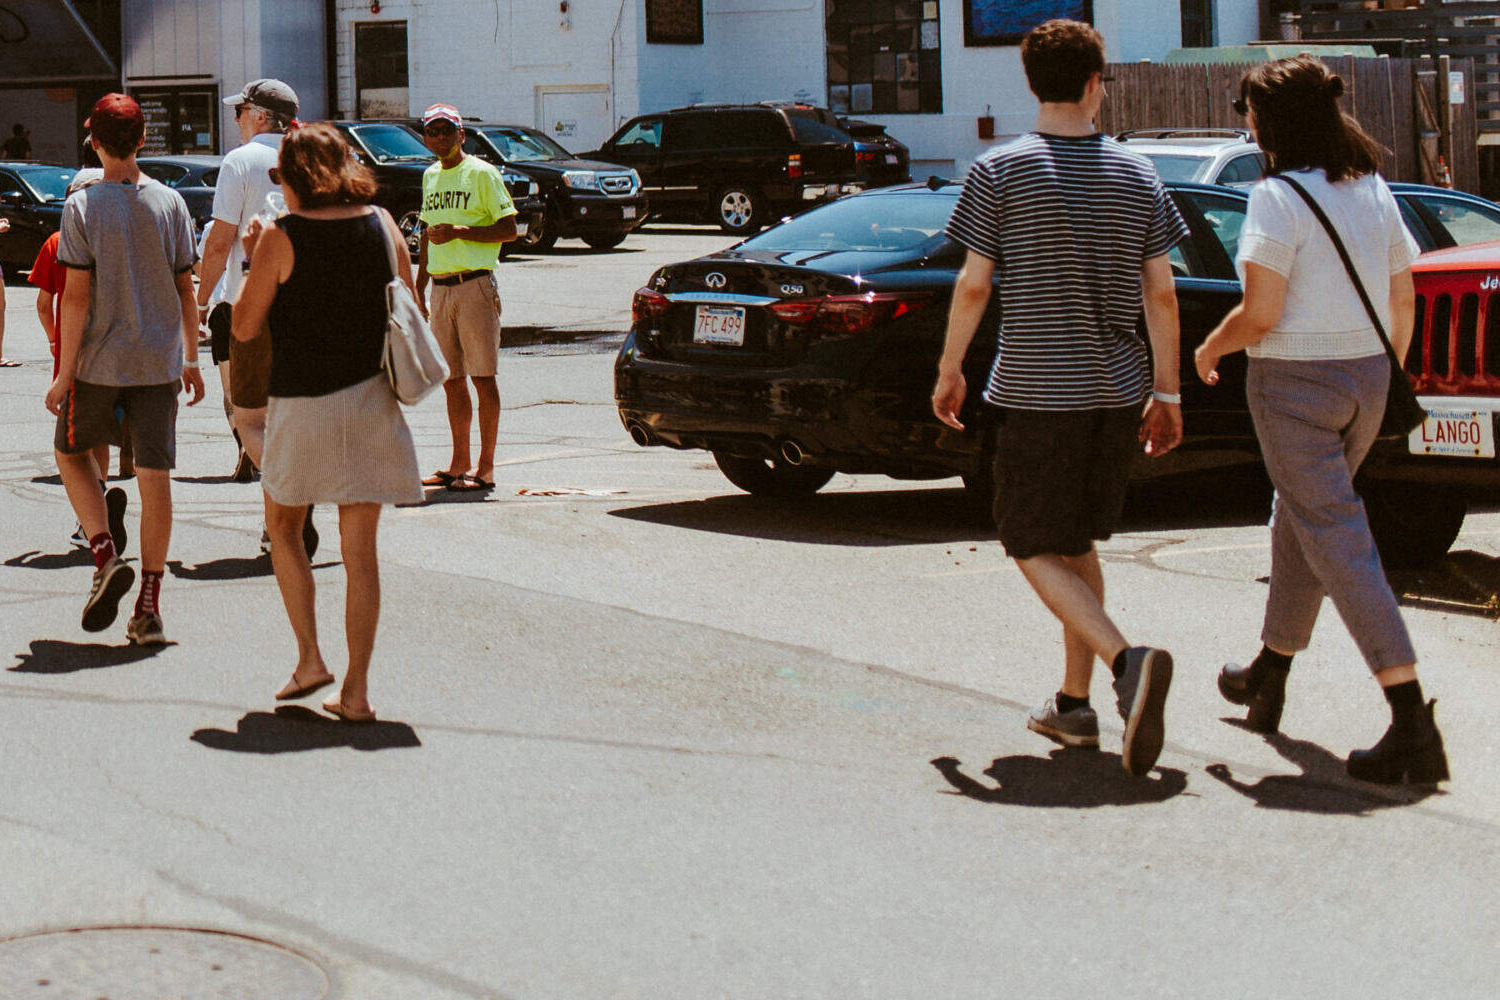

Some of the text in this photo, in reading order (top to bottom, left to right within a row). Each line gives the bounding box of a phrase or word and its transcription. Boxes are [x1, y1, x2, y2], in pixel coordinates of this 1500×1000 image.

[424, 190, 471, 211] SECURITY
[780, 284, 804, 295] Q50
[1480, 274, 1500, 290] Je
[698, 315, 742, 336] 7FC 499
[1421, 420, 1481, 445] LANGO
